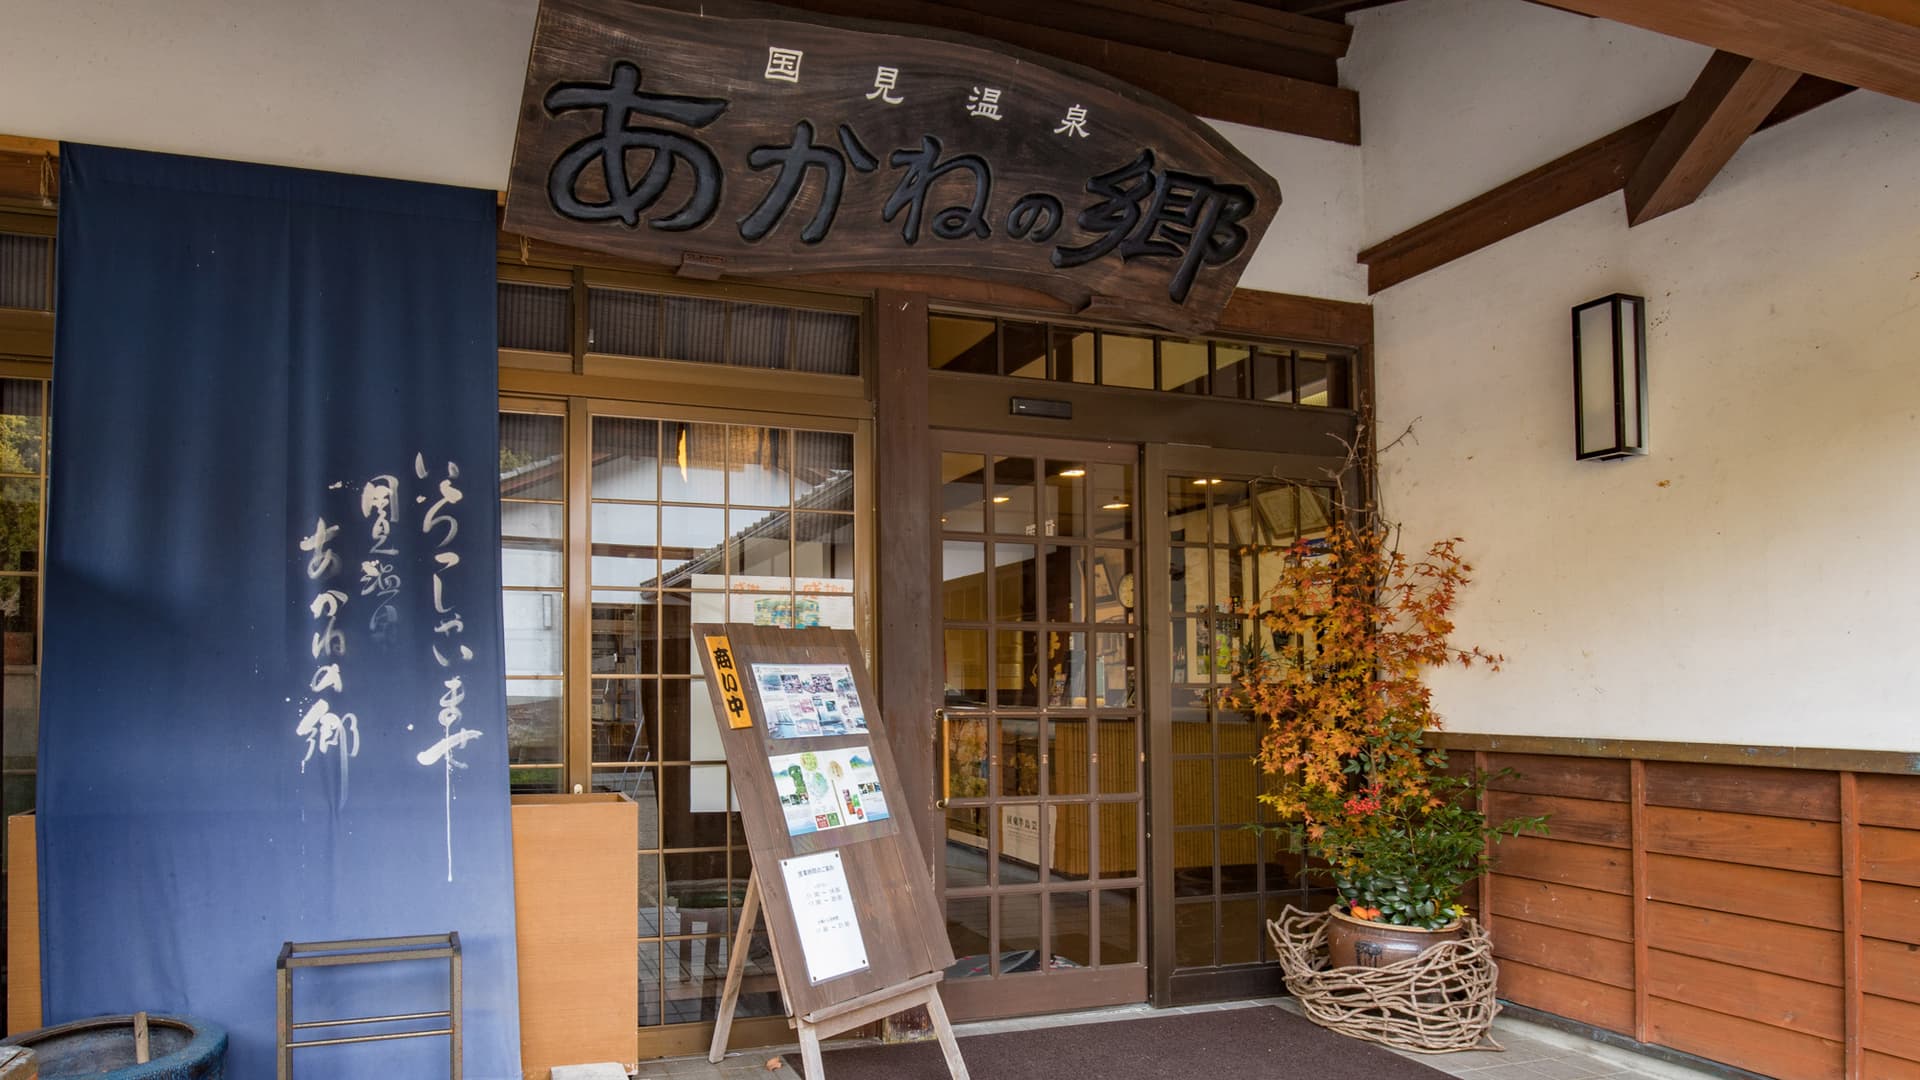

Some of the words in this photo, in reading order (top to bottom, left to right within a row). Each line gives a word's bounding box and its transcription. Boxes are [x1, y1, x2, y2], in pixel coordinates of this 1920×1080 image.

[764, 46, 1091, 139] 国見温泉
[541, 60, 1259, 303] あかねの郷
[712, 647, 745, 718] 商い中
